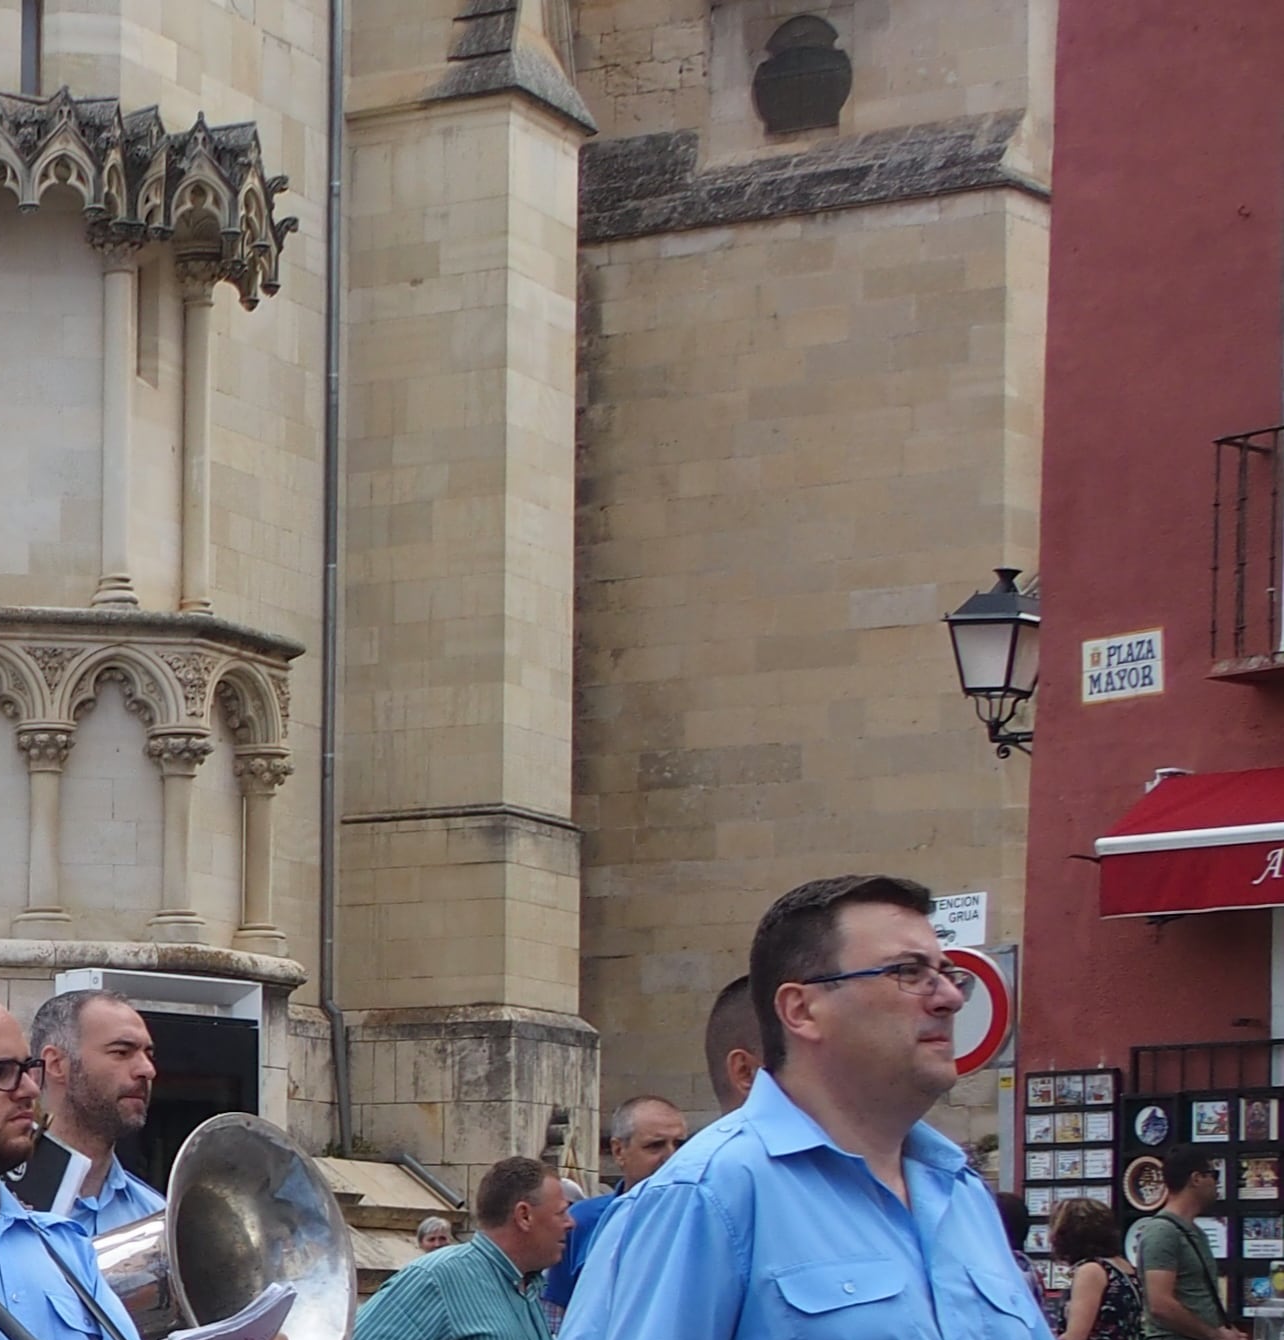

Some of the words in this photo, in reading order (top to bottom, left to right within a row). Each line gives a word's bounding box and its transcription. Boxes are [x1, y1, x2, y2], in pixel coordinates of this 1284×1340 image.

[1106, 638, 1156, 667] PLAZA
[1088, 664, 1154, 695] MAYOR
[948, 910, 980, 924] GRUA
